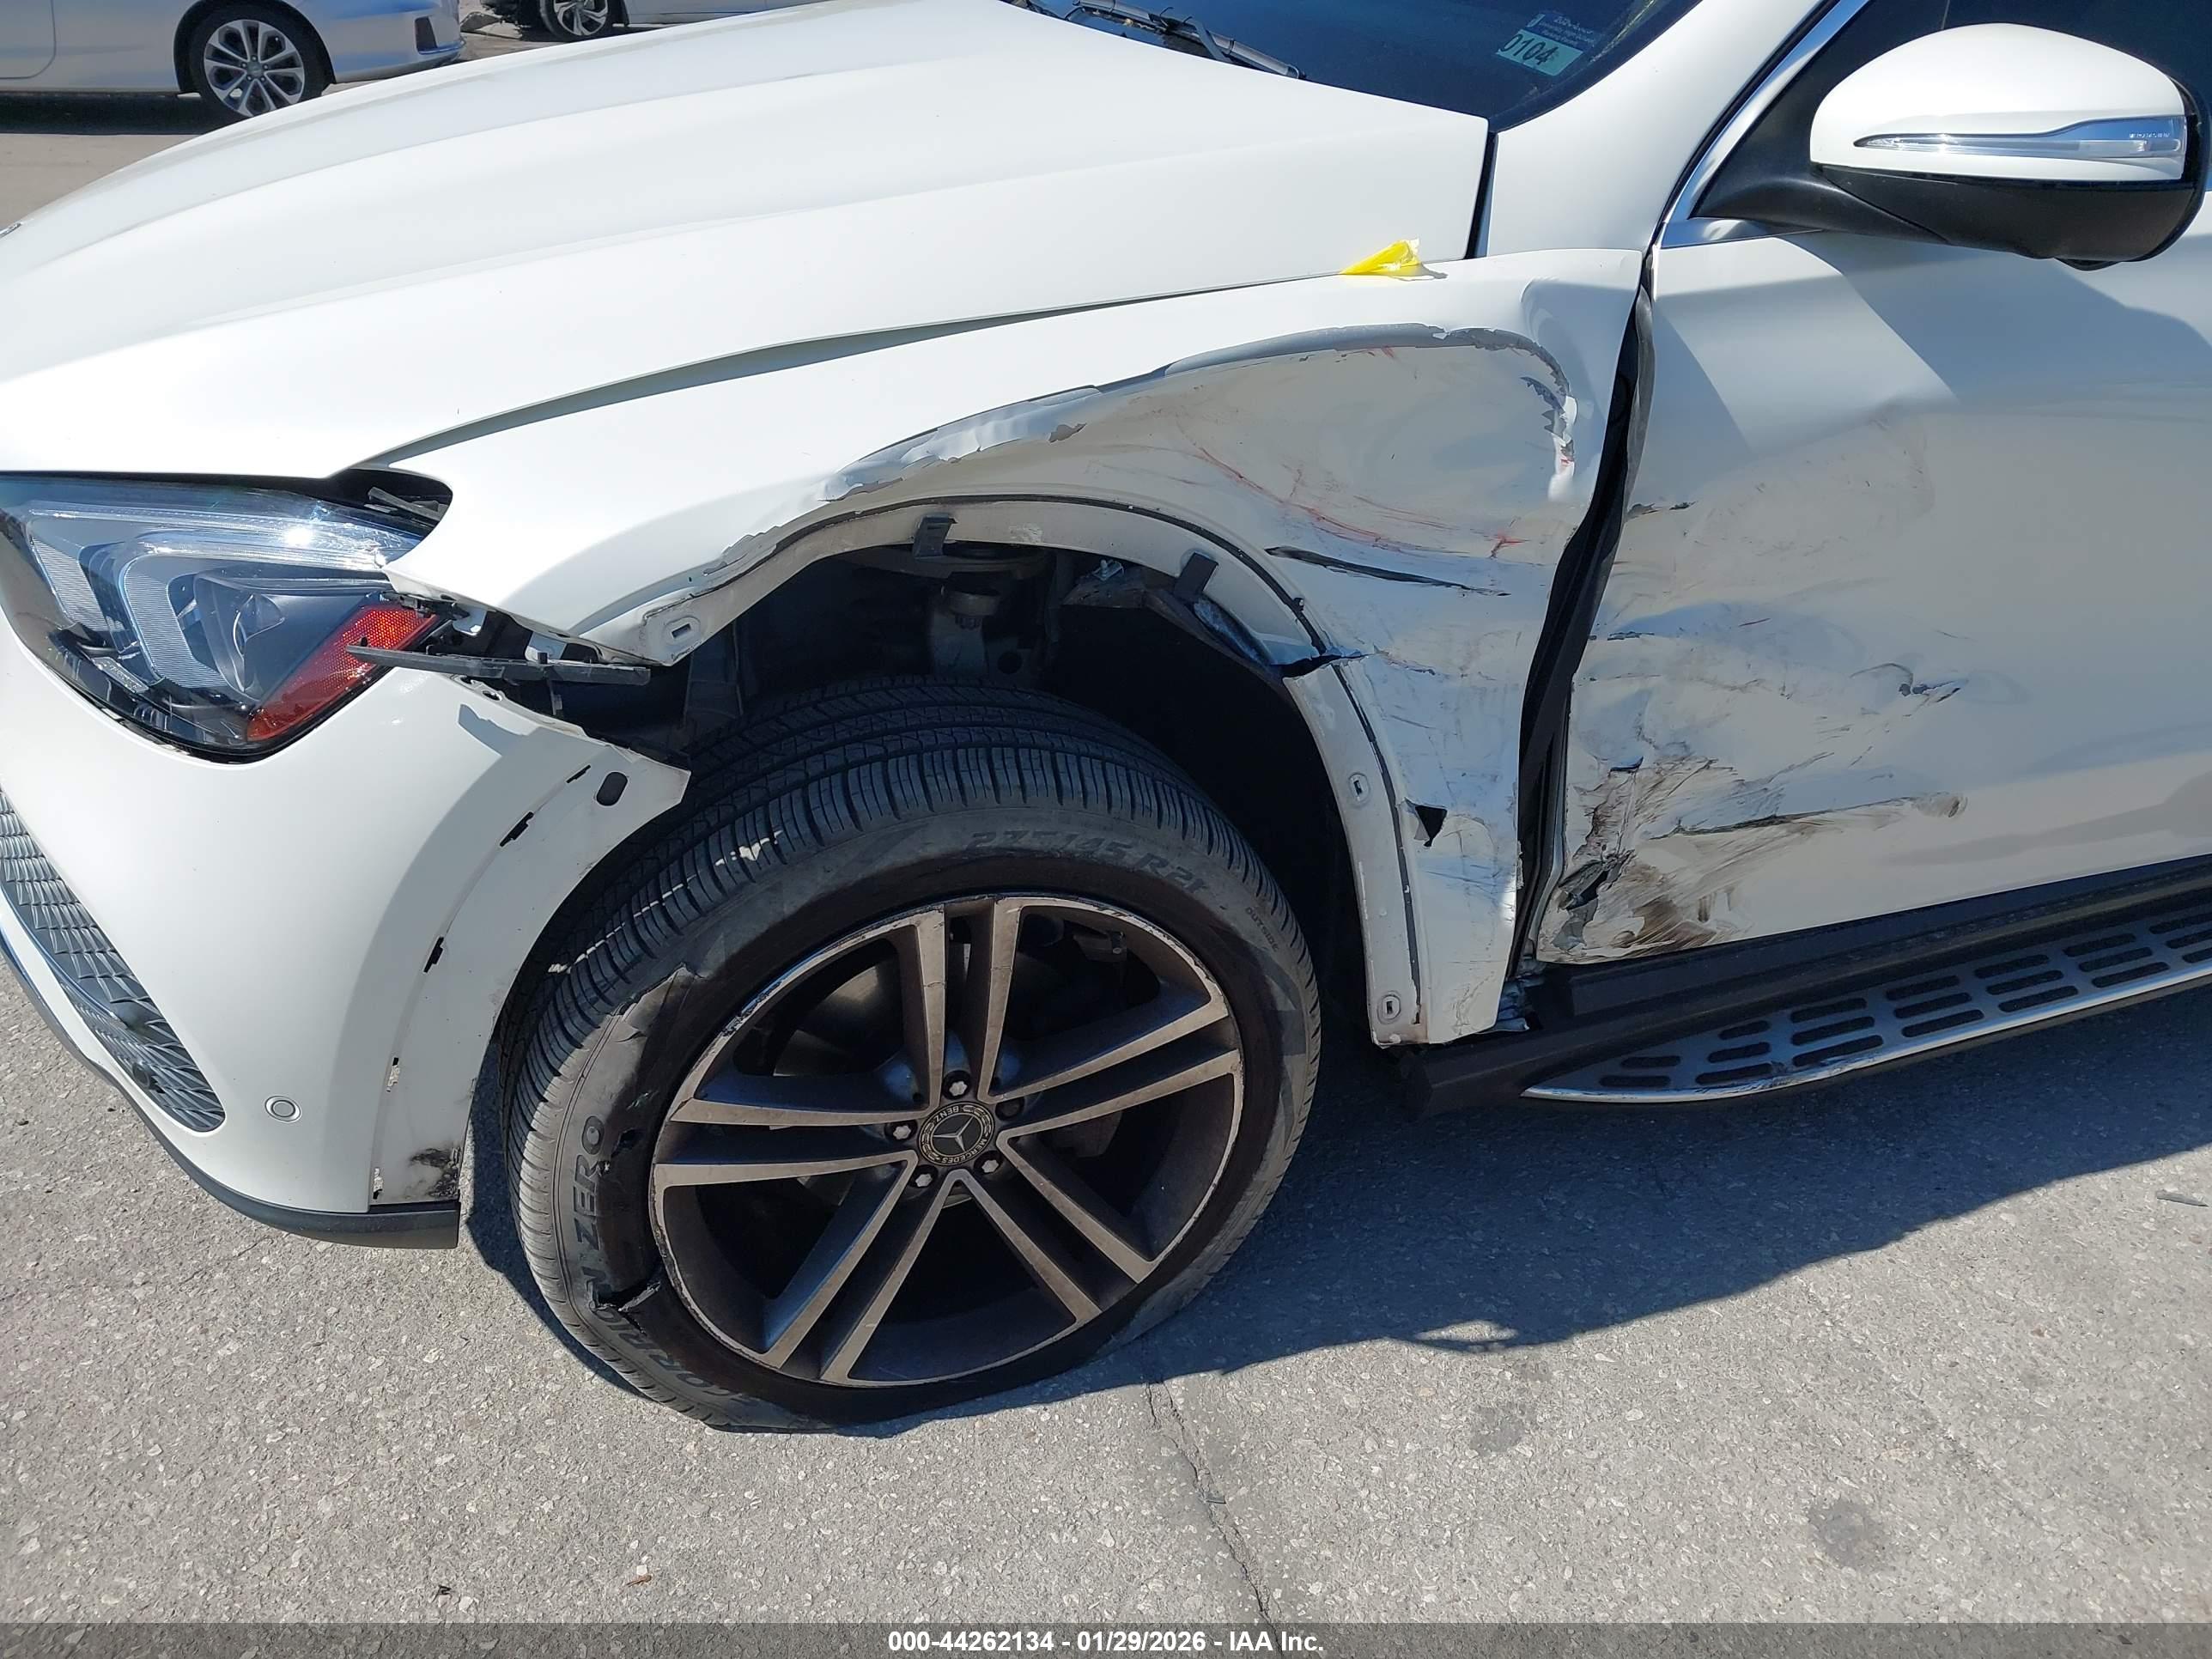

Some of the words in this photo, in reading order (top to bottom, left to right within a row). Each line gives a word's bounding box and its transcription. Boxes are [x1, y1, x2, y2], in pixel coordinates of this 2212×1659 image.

[934, 1105, 959, 1122] BENZ
[941, 1138, 988, 1164] MERCEDES
[572, 1115, 605, 1251] ZERO
